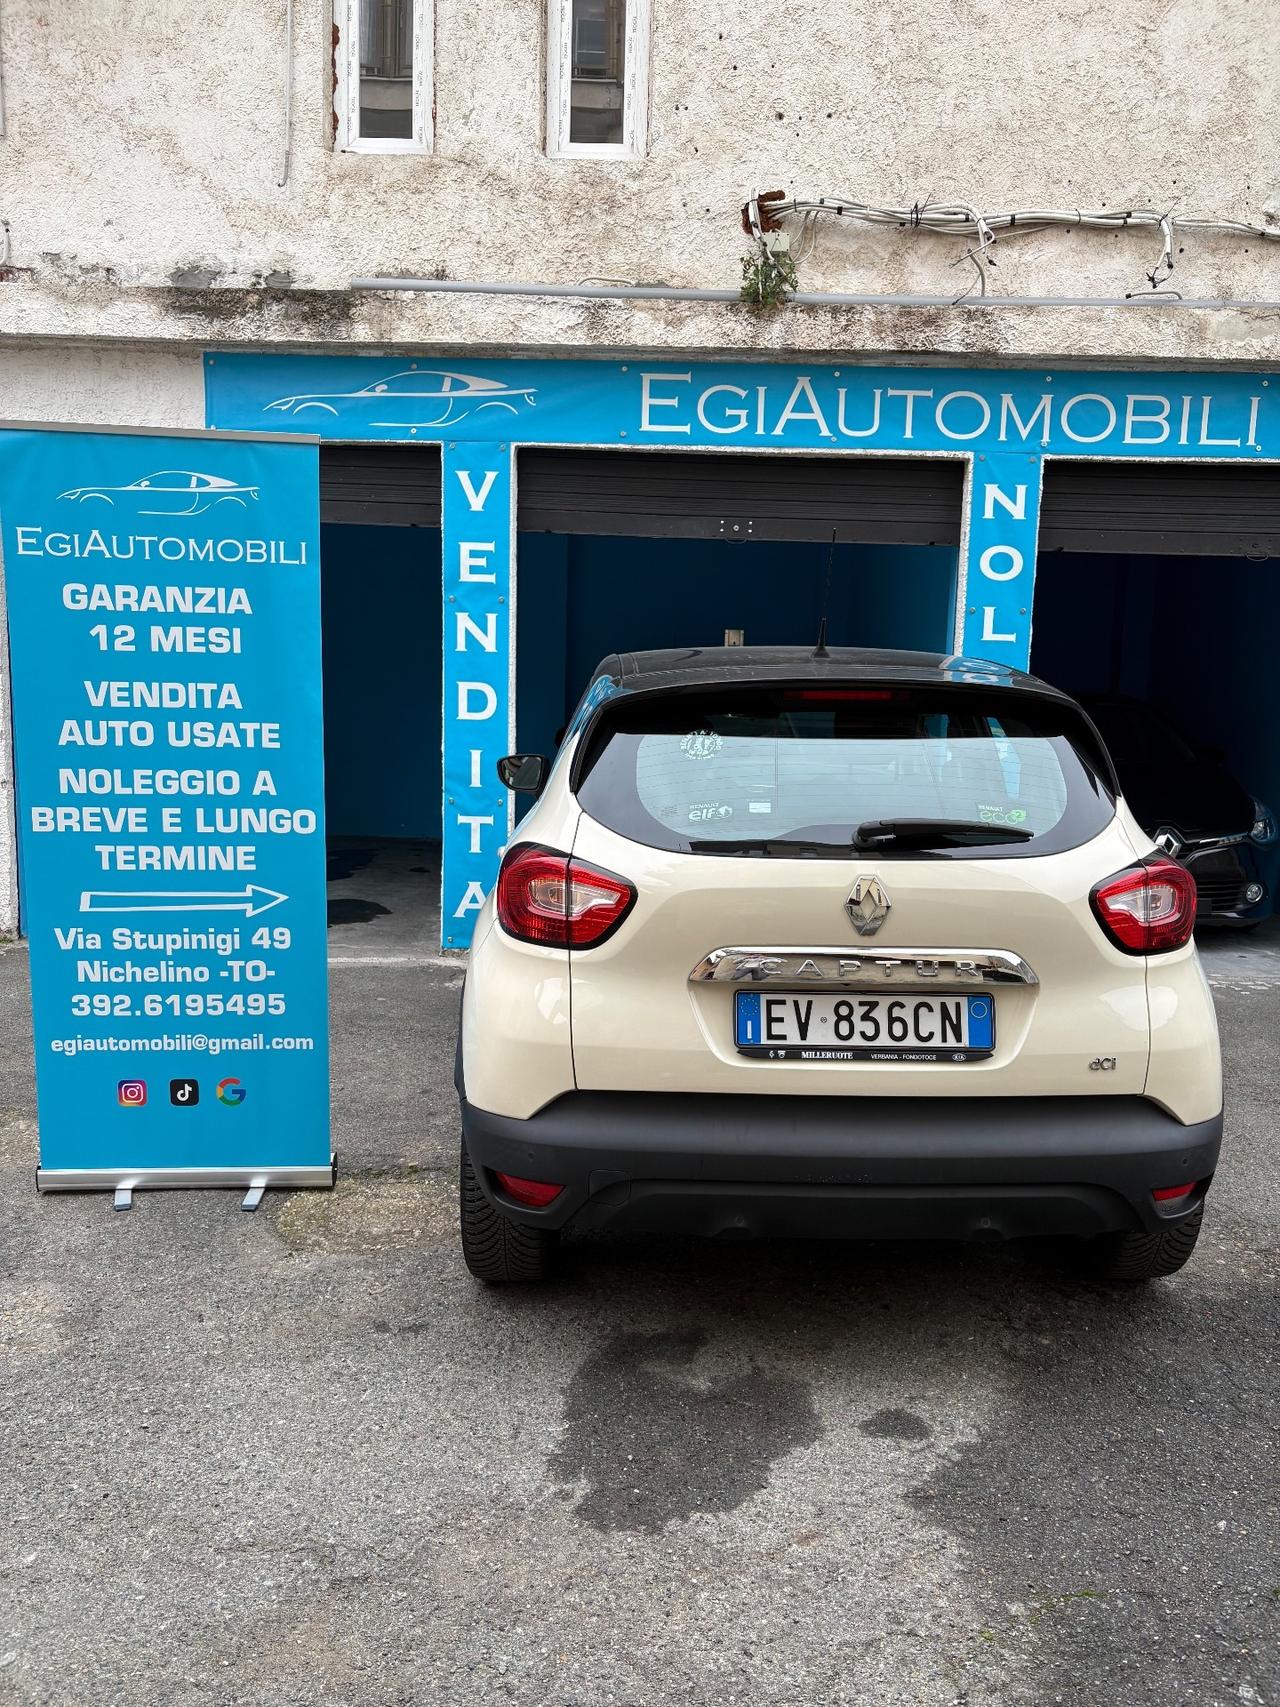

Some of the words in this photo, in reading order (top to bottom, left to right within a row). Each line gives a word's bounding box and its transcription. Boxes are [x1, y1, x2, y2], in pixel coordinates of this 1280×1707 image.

[62, 582, 254, 615] GARANZIA
[89, 624, 136, 652] 12
[150, 625, 242, 654] MESI
[84, 680, 243, 710] VENDITA
[58, 719, 155, 747] AUTO
[168, 721, 281, 749] USATE
[59, 768, 241, 796] NOLEGGIO
[252, 770, 278, 796] A
[31, 806, 149, 833] BREVE
[162, 807, 183, 833] E
[196, 807, 317, 835] LUNGO
[689, 808, 716, 821] elf
[95, 845, 258, 871] TERMINE
[53, 927, 102, 951] Via
[112, 927, 241, 956] Stupinigi
[251, 927, 292, 950] 49
[76, 960, 210, 983] Nichelino
[219, 960, 276, 983] -TO-
[759, 958, 979, 978] CAPTUR
[71, 993, 286, 1017] 392.6195495
[765, 999, 814, 1041] EV
[833, 1000, 964, 1043] 836CN
[50, 1033, 315, 1056] egiautomobili@gmail.com
[801, 1051, 853, 1059] MILLERUOTE
[1089, 1057, 1116, 1071] dCi
